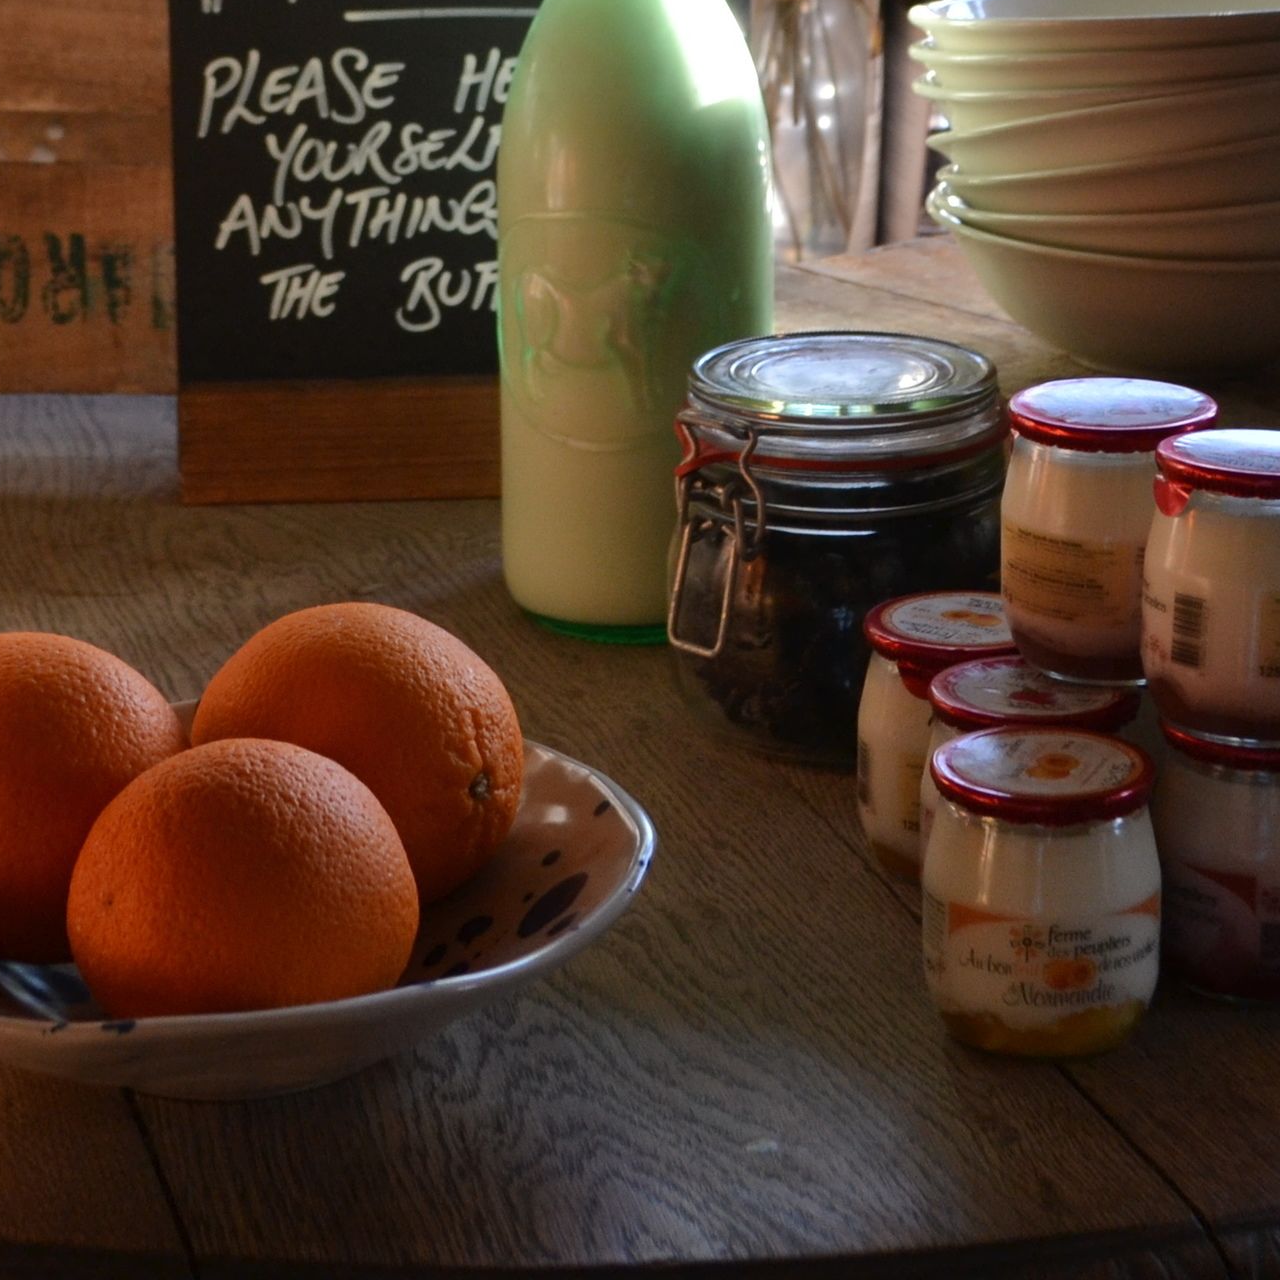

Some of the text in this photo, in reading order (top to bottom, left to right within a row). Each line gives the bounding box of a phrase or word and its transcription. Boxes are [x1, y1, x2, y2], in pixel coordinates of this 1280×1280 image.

[197, 47, 520, 138] PLEASE HE
[259, 256, 499, 332] THE BUF
[1047, 924, 1093, 946] ferme
